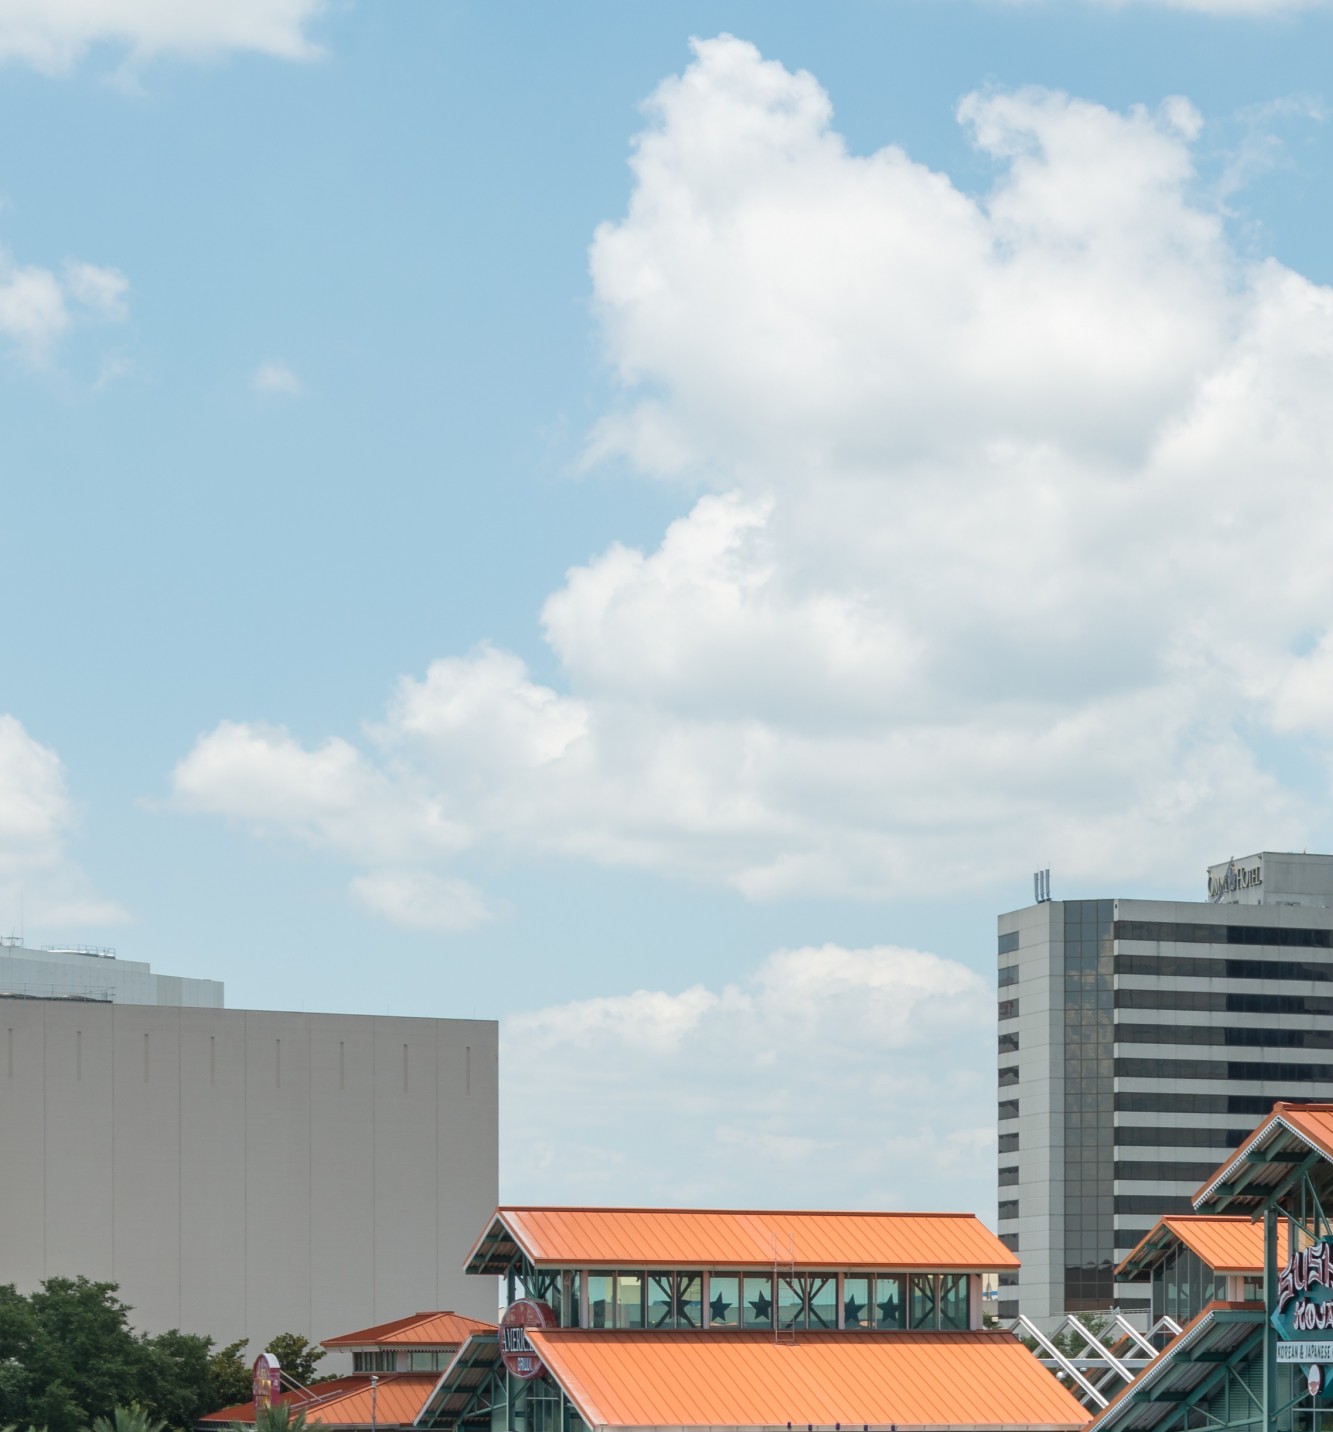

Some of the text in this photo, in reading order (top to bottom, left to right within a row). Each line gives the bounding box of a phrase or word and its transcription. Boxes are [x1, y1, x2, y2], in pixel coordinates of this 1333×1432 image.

[1277, 1344, 1299, 1359] KOREAN
[1299, 1345, 1304, 1359] &
[1305, 1345, 1331, 1359] JAPANESE
